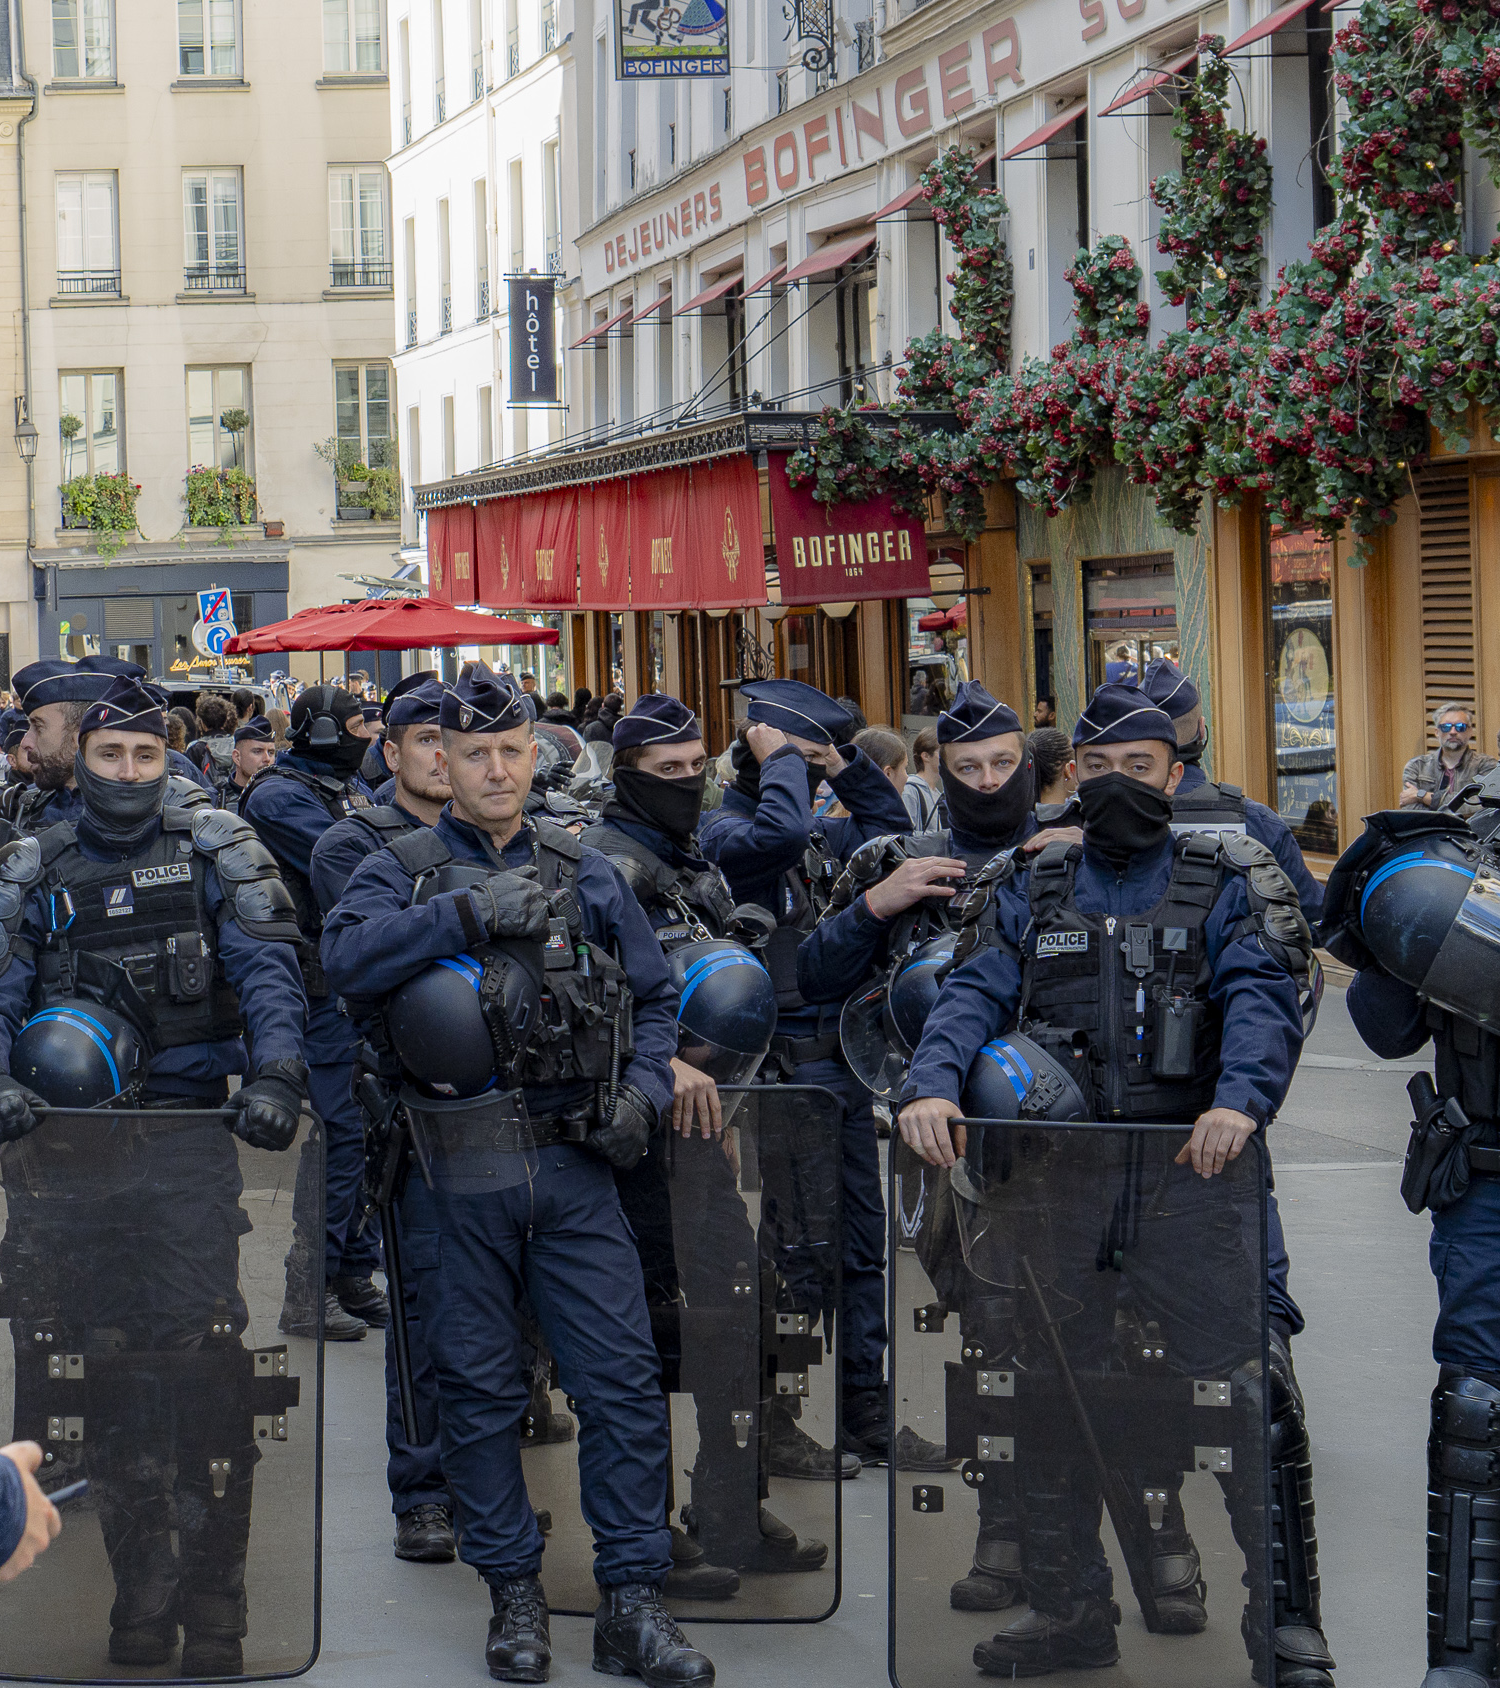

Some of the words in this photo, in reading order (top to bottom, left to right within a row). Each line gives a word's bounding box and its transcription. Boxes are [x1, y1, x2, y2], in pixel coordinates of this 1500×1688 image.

[625, 59, 727, 76] BOFINGER
[743, 16, 1025, 206] BOFINGER
[604, 181, 722, 274] DEJEUNERS
[526, 289, 540, 392] hôtel
[792, 529, 912, 568] BOFINGER
[845, 567, 864, 577] 1864
[135, 864, 189, 882] POLICE
[1039, 932, 1087, 948] POLICE
